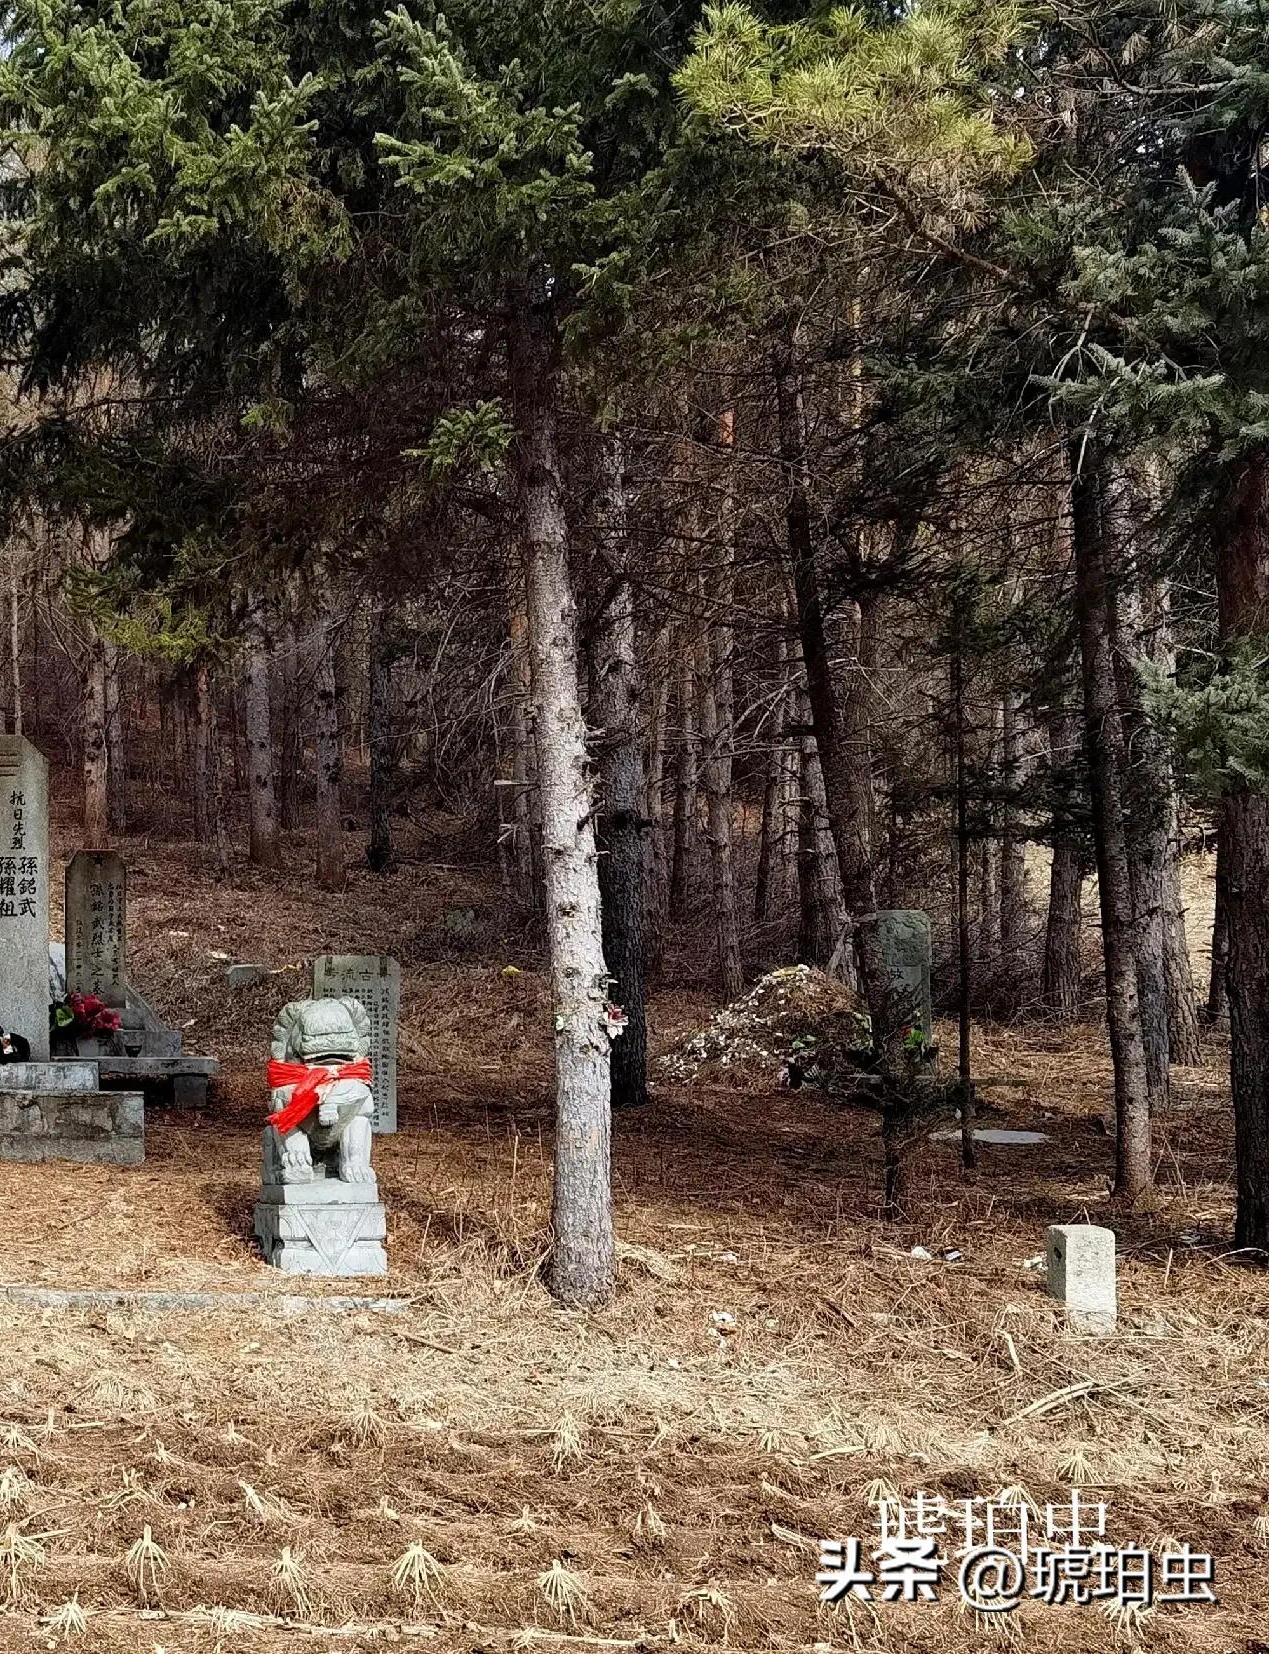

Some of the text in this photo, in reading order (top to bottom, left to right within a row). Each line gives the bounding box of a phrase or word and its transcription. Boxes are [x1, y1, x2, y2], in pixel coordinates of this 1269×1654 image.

[9, 790, 26, 850] 抗日先烈
[18, 856, 38, 918] 孫銘武
